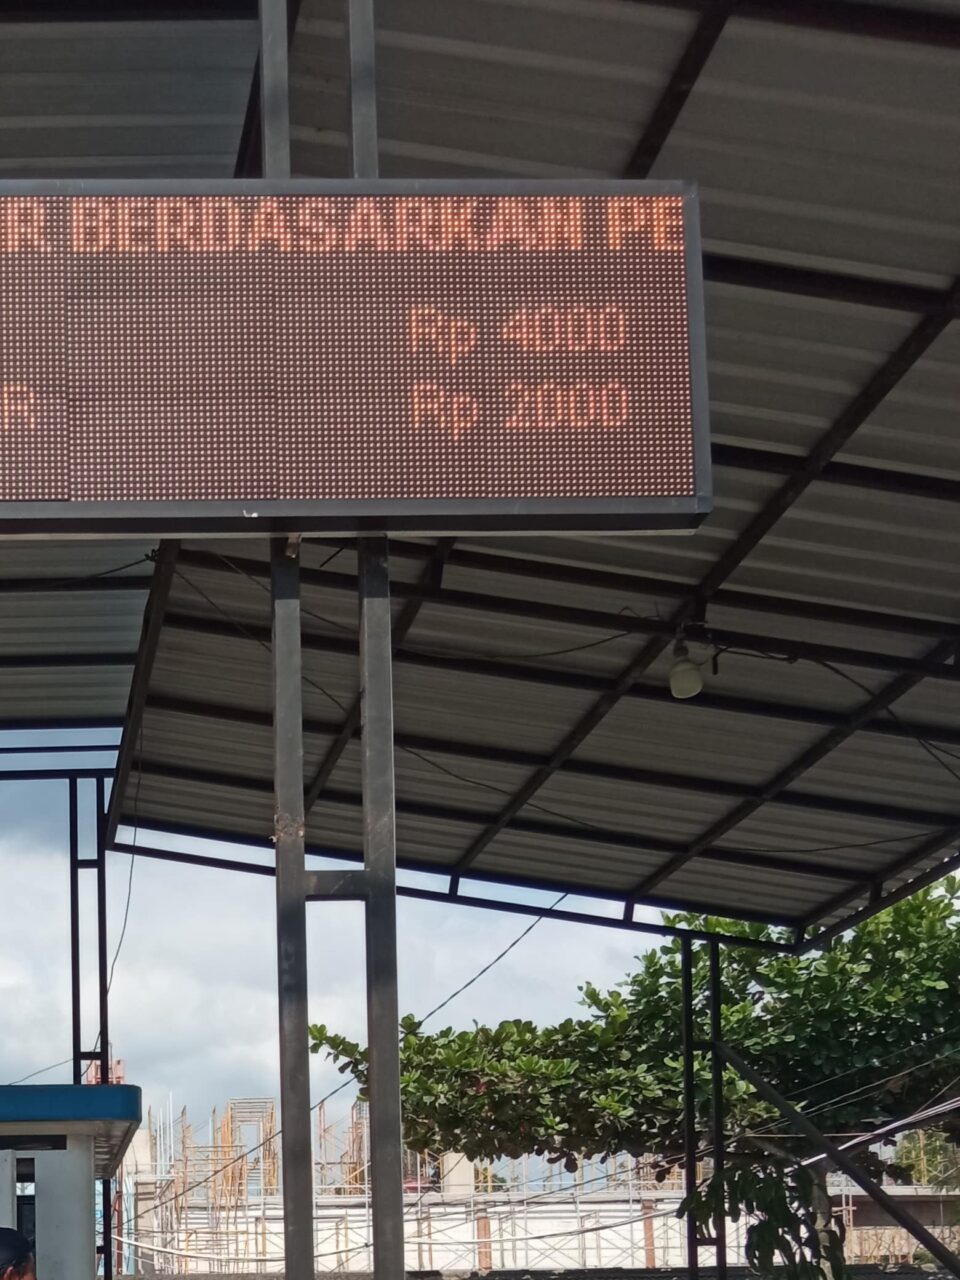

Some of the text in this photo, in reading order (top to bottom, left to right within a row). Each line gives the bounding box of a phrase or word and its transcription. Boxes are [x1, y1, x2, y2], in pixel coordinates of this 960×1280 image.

[69, 195, 584, 252] BERDASARKAN
[409, 307, 628, 363] Rp 4000
[410, 383, 630, 439] Rp 2000
